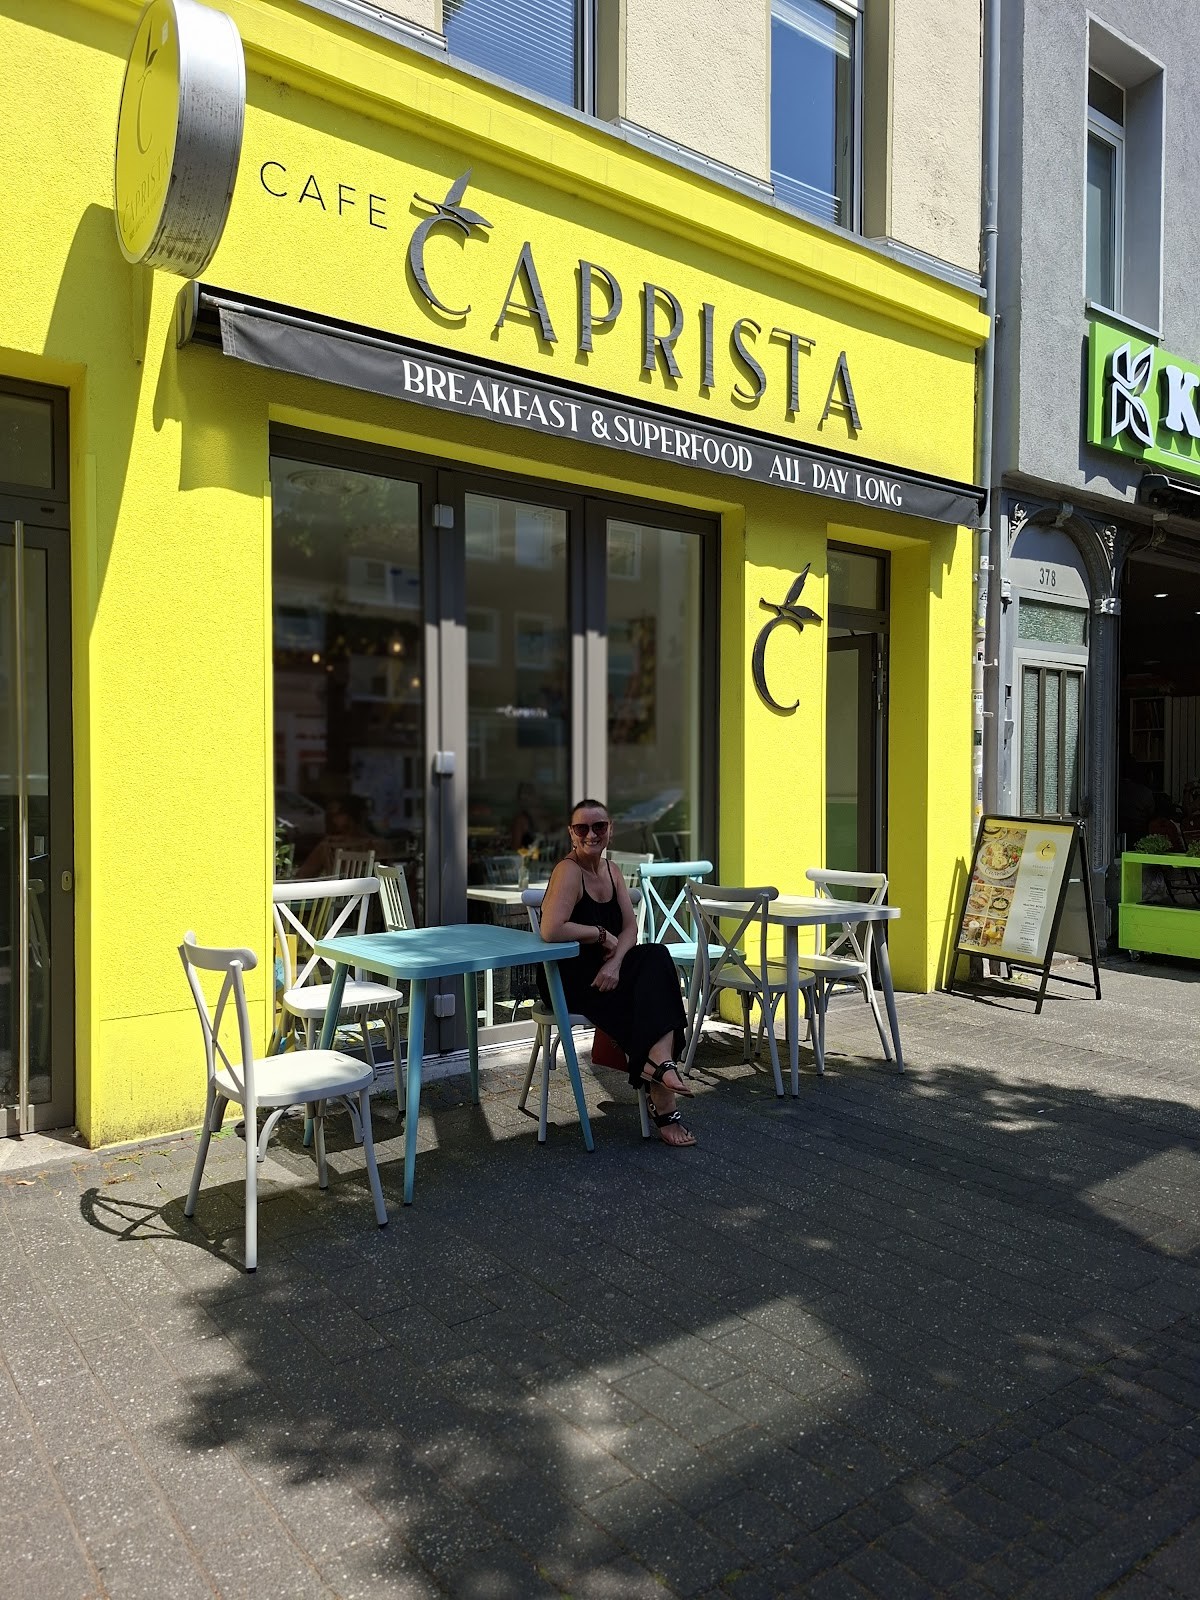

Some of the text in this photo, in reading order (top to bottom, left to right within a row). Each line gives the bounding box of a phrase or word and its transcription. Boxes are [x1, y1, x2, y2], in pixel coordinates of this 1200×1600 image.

[122, 147, 169, 232] CAPRISTA
[260, 161, 387, 230] CAFE
[409, 211, 862, 430] CAPRISTA
[402, 359, 582, 432] BREAKFAST
[769, 454, 806, 486] ALL
[812, 463, 848, 495] DAY
[856, 474, 903, 507] LONG
[1039, 567, 1056, 587] 378
